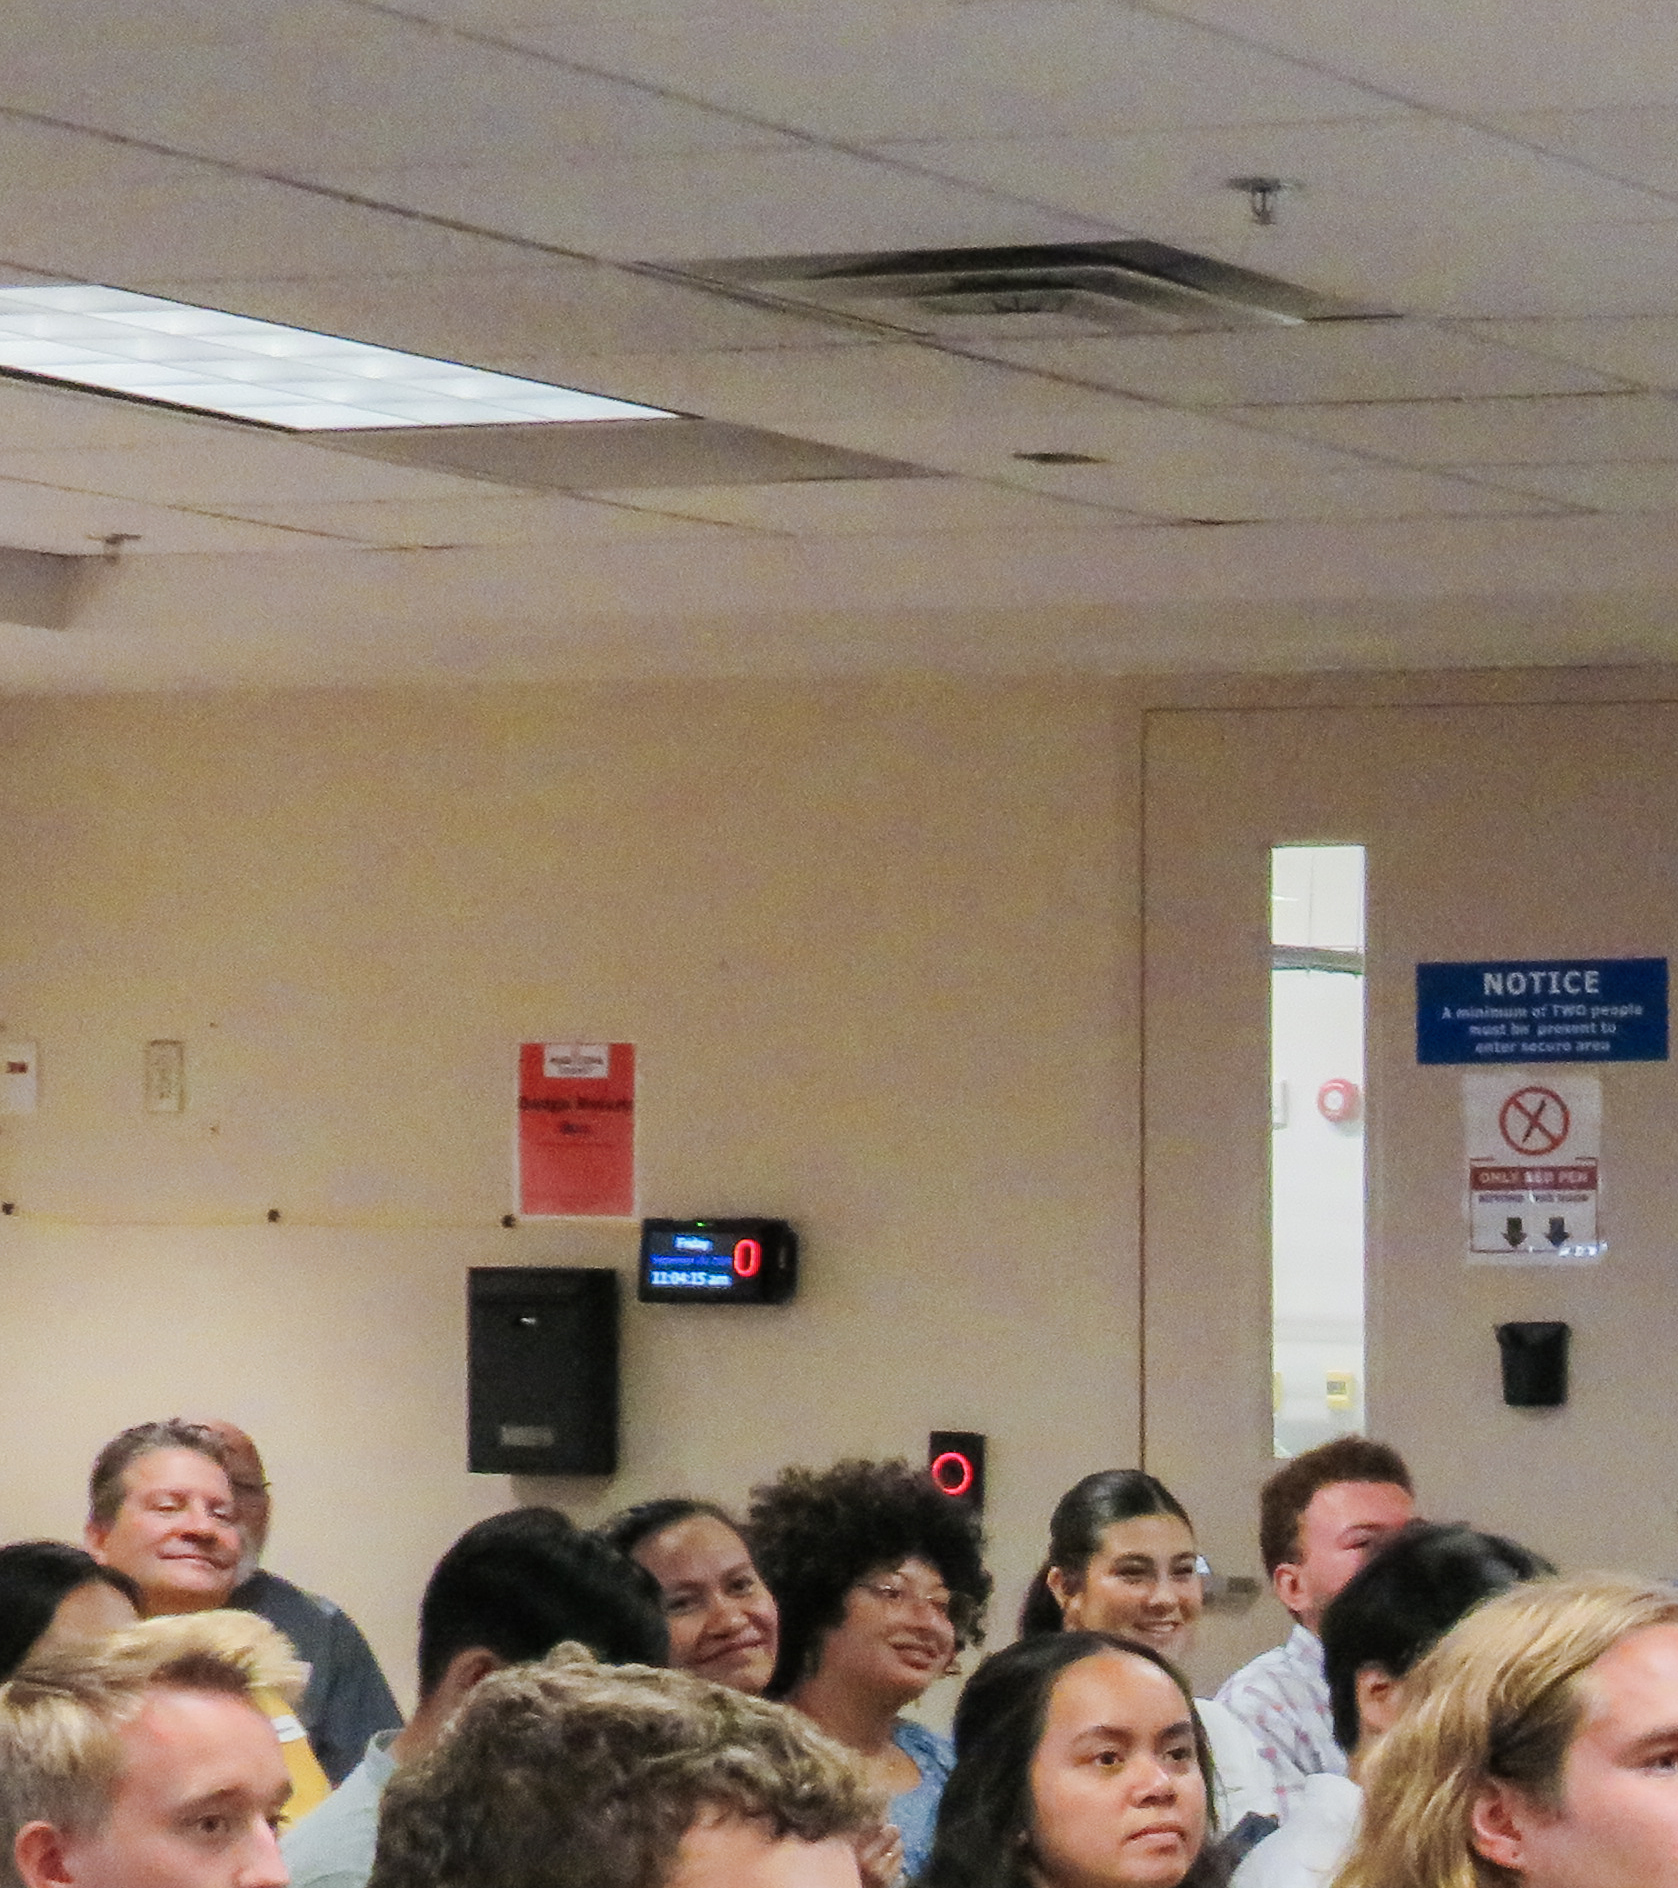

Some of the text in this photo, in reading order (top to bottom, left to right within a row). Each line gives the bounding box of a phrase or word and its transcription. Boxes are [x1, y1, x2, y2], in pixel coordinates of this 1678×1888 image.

[1483, 970, 1600, 996] NOTICE
[1441, 1006, 1452, 1020] A
[1456, 1006, 1528, 1019] minimum
[1552, 1004, 1586, 1016] TWO
[1591, 1004, 1644, 1019] people
[1601, 1021, 1617, 1034] to
